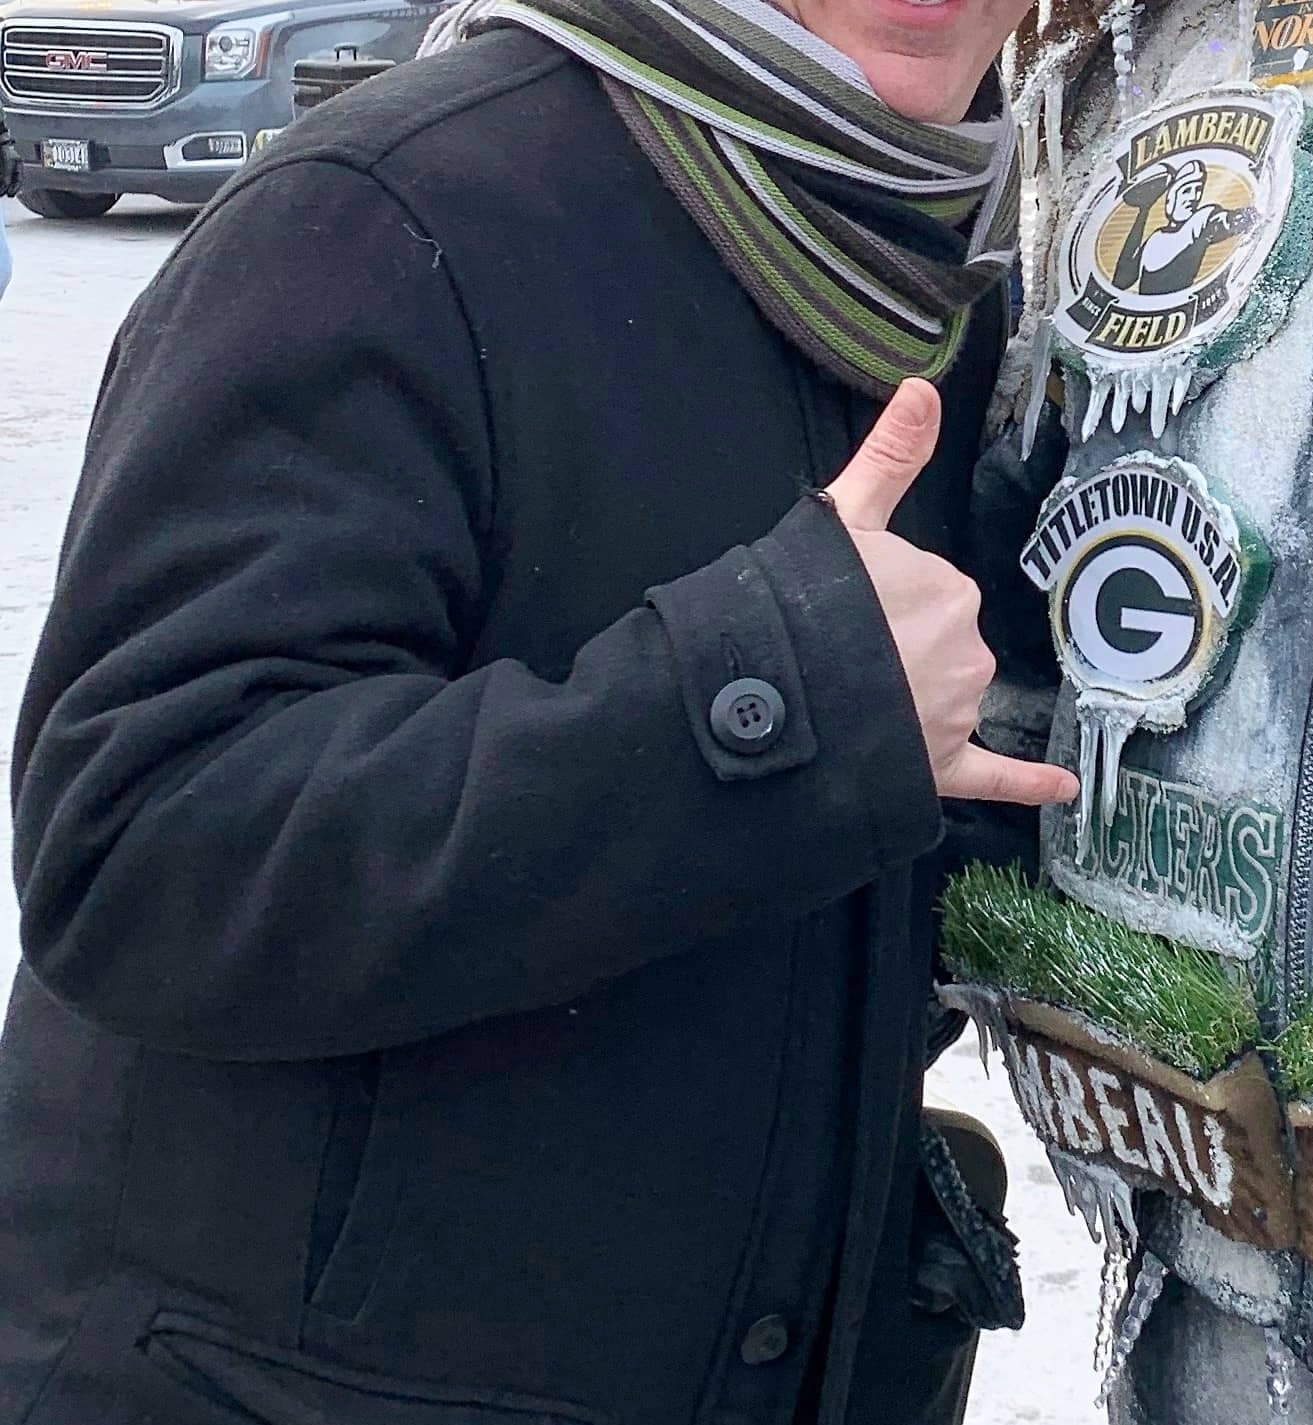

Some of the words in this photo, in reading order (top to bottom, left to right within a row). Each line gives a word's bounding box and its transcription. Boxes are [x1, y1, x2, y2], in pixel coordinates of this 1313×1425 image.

[46, 49, 107, 73] GMC
[1135, 110, 1269, 171] LAMBEAU
[1096, 310, 1187, 348] FIELD
[1022, 472, 1179, 581] TITLETOWN
[1070, 768, 1278, 942] CKERS
